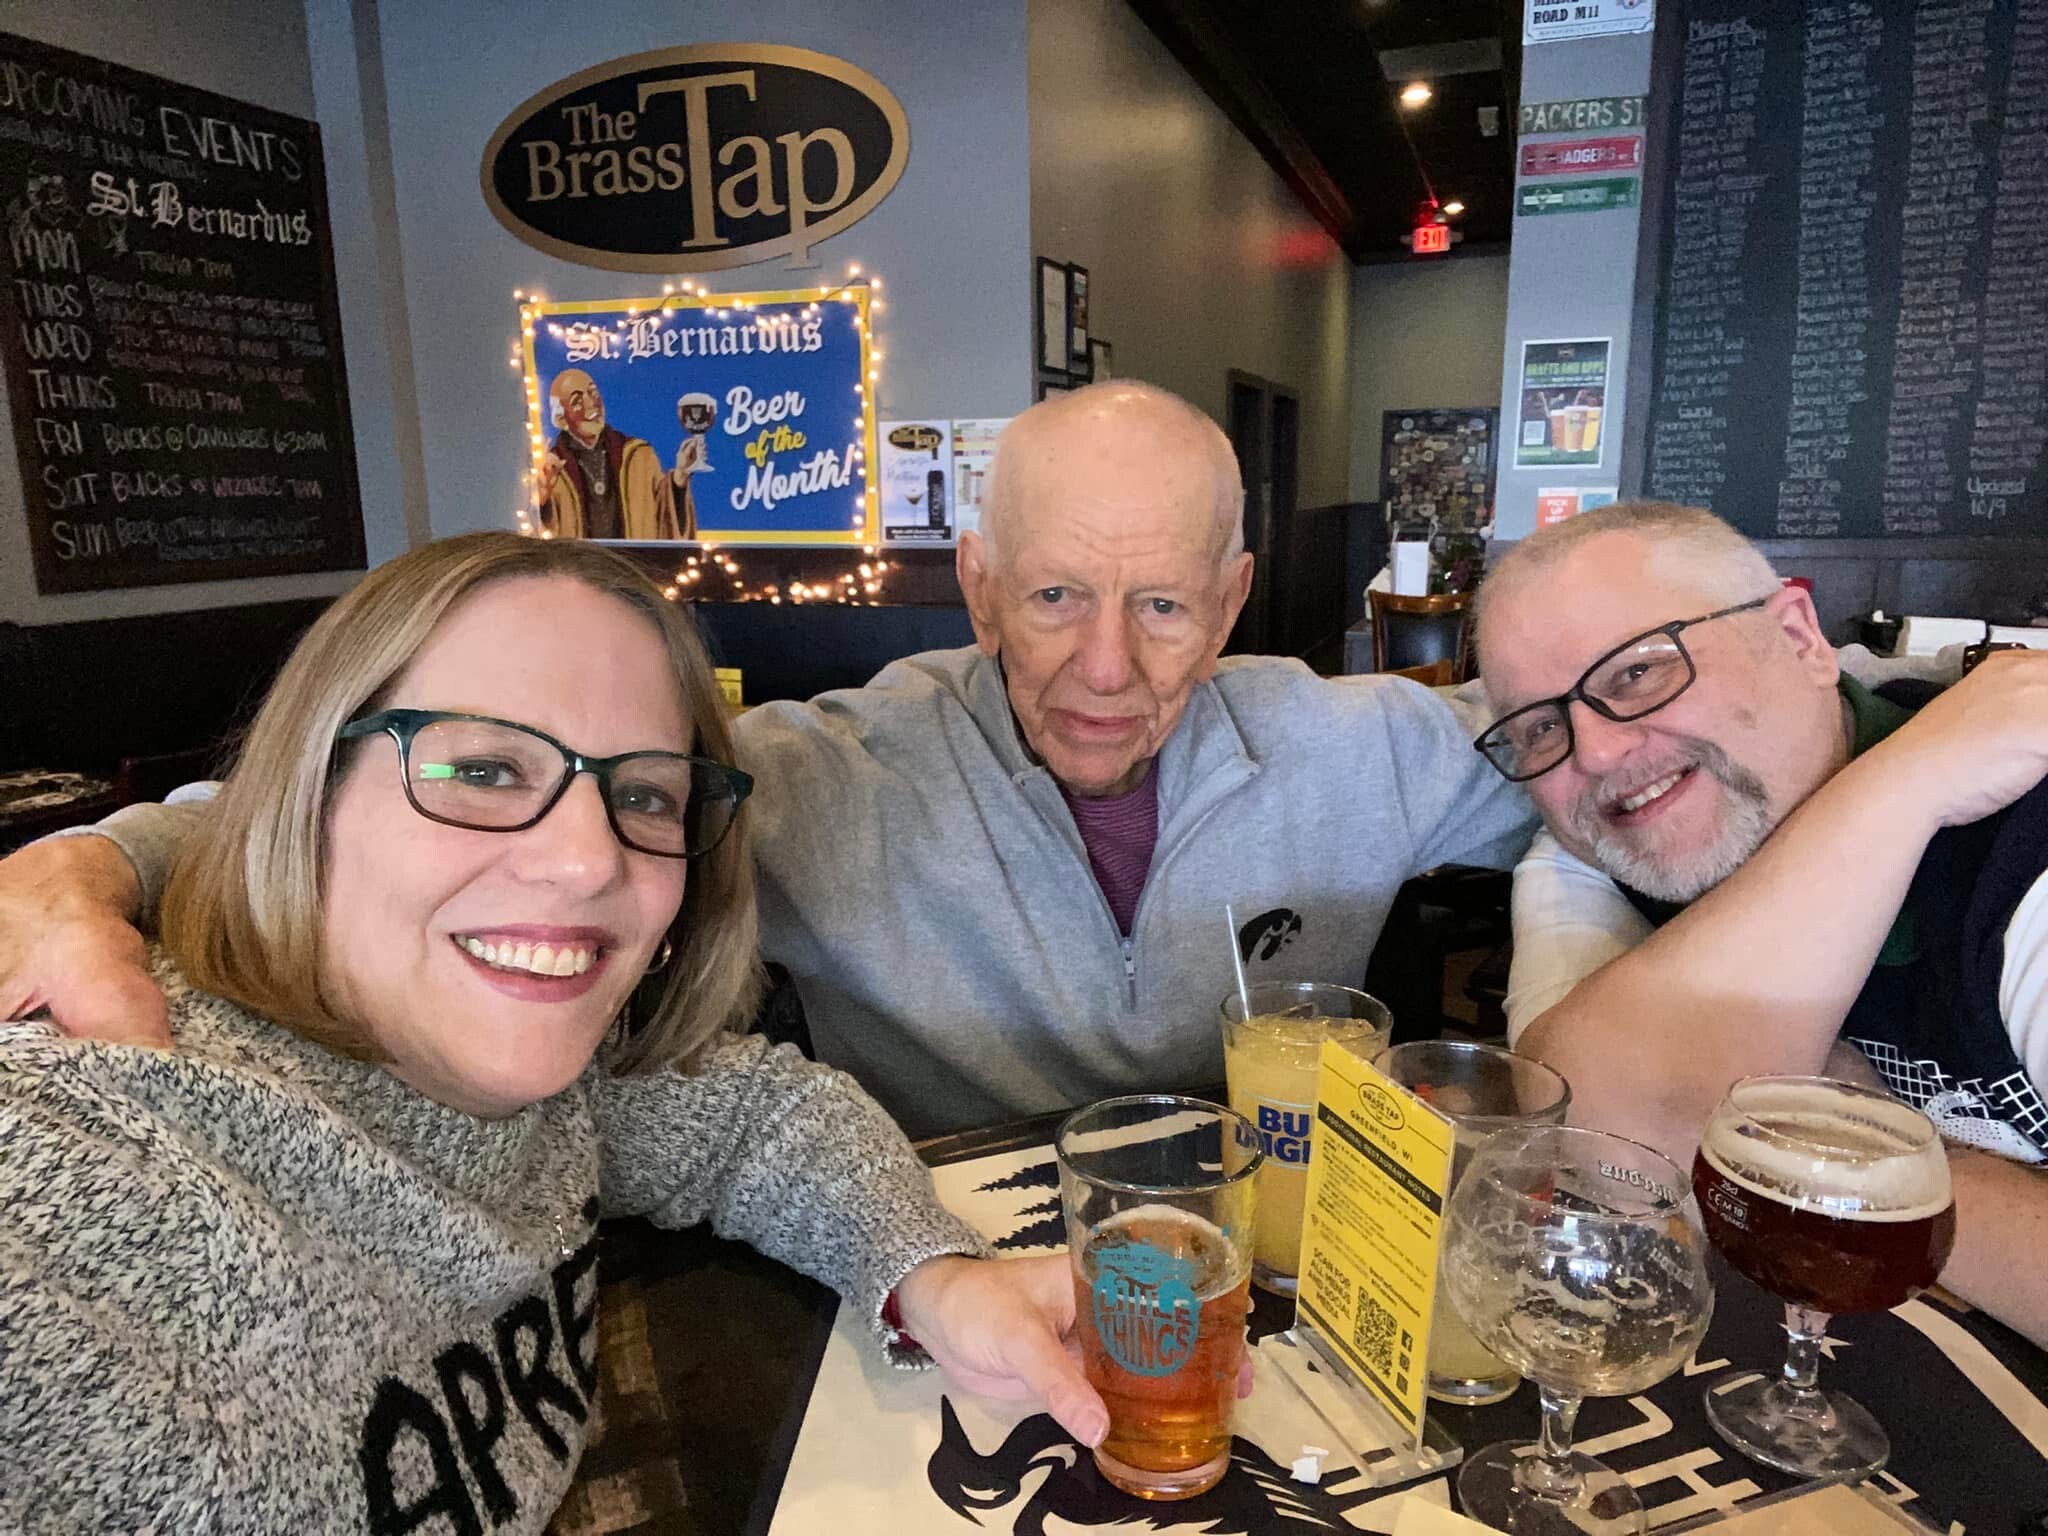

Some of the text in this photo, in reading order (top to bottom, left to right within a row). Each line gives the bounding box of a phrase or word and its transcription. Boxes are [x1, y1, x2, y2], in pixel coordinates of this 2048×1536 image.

[1533, 9, 1569, 24] ROAD
[561, 103, 637, 147] The
[1520, 100, 1614, 133] PACKERS
[159, 106, 303, 182] EVENTS
[522, 69, 857, 271] Brass Tap
[149, 181, 313, 246] Bernardus
[1418, 230, 1446, 248] EXIT
[564, 317, 824, 364] St. Bernardus
[723, 385, 806, 436] Beer
[35, 418, 83, 456] FRI
[744, 424, 807, 468] of the
[730, 443, 856, 511] Month!
[1971, 499, 2007, 519] 10/9
[1258, 1105, 1310, 1138] BU
[1362, 1142, 1407, 1182] RESTAURANT
[1406, 1178, 1432, 1203] NOTES
[1310, 1259, 1323, 1278] ALL
[1325, 1272, 1350, 1305] MENUS
[1313, 1247, 1351, 1289] SCAN FOR
[1100, 1274, 1193, 1327] LITTLE
[1307, 1268, 1352, 1321] AND SOCIAL
[1316, 1290, 1339, 1320] MEDIA
[1100, 1314, 1190, 1370] THINGS
